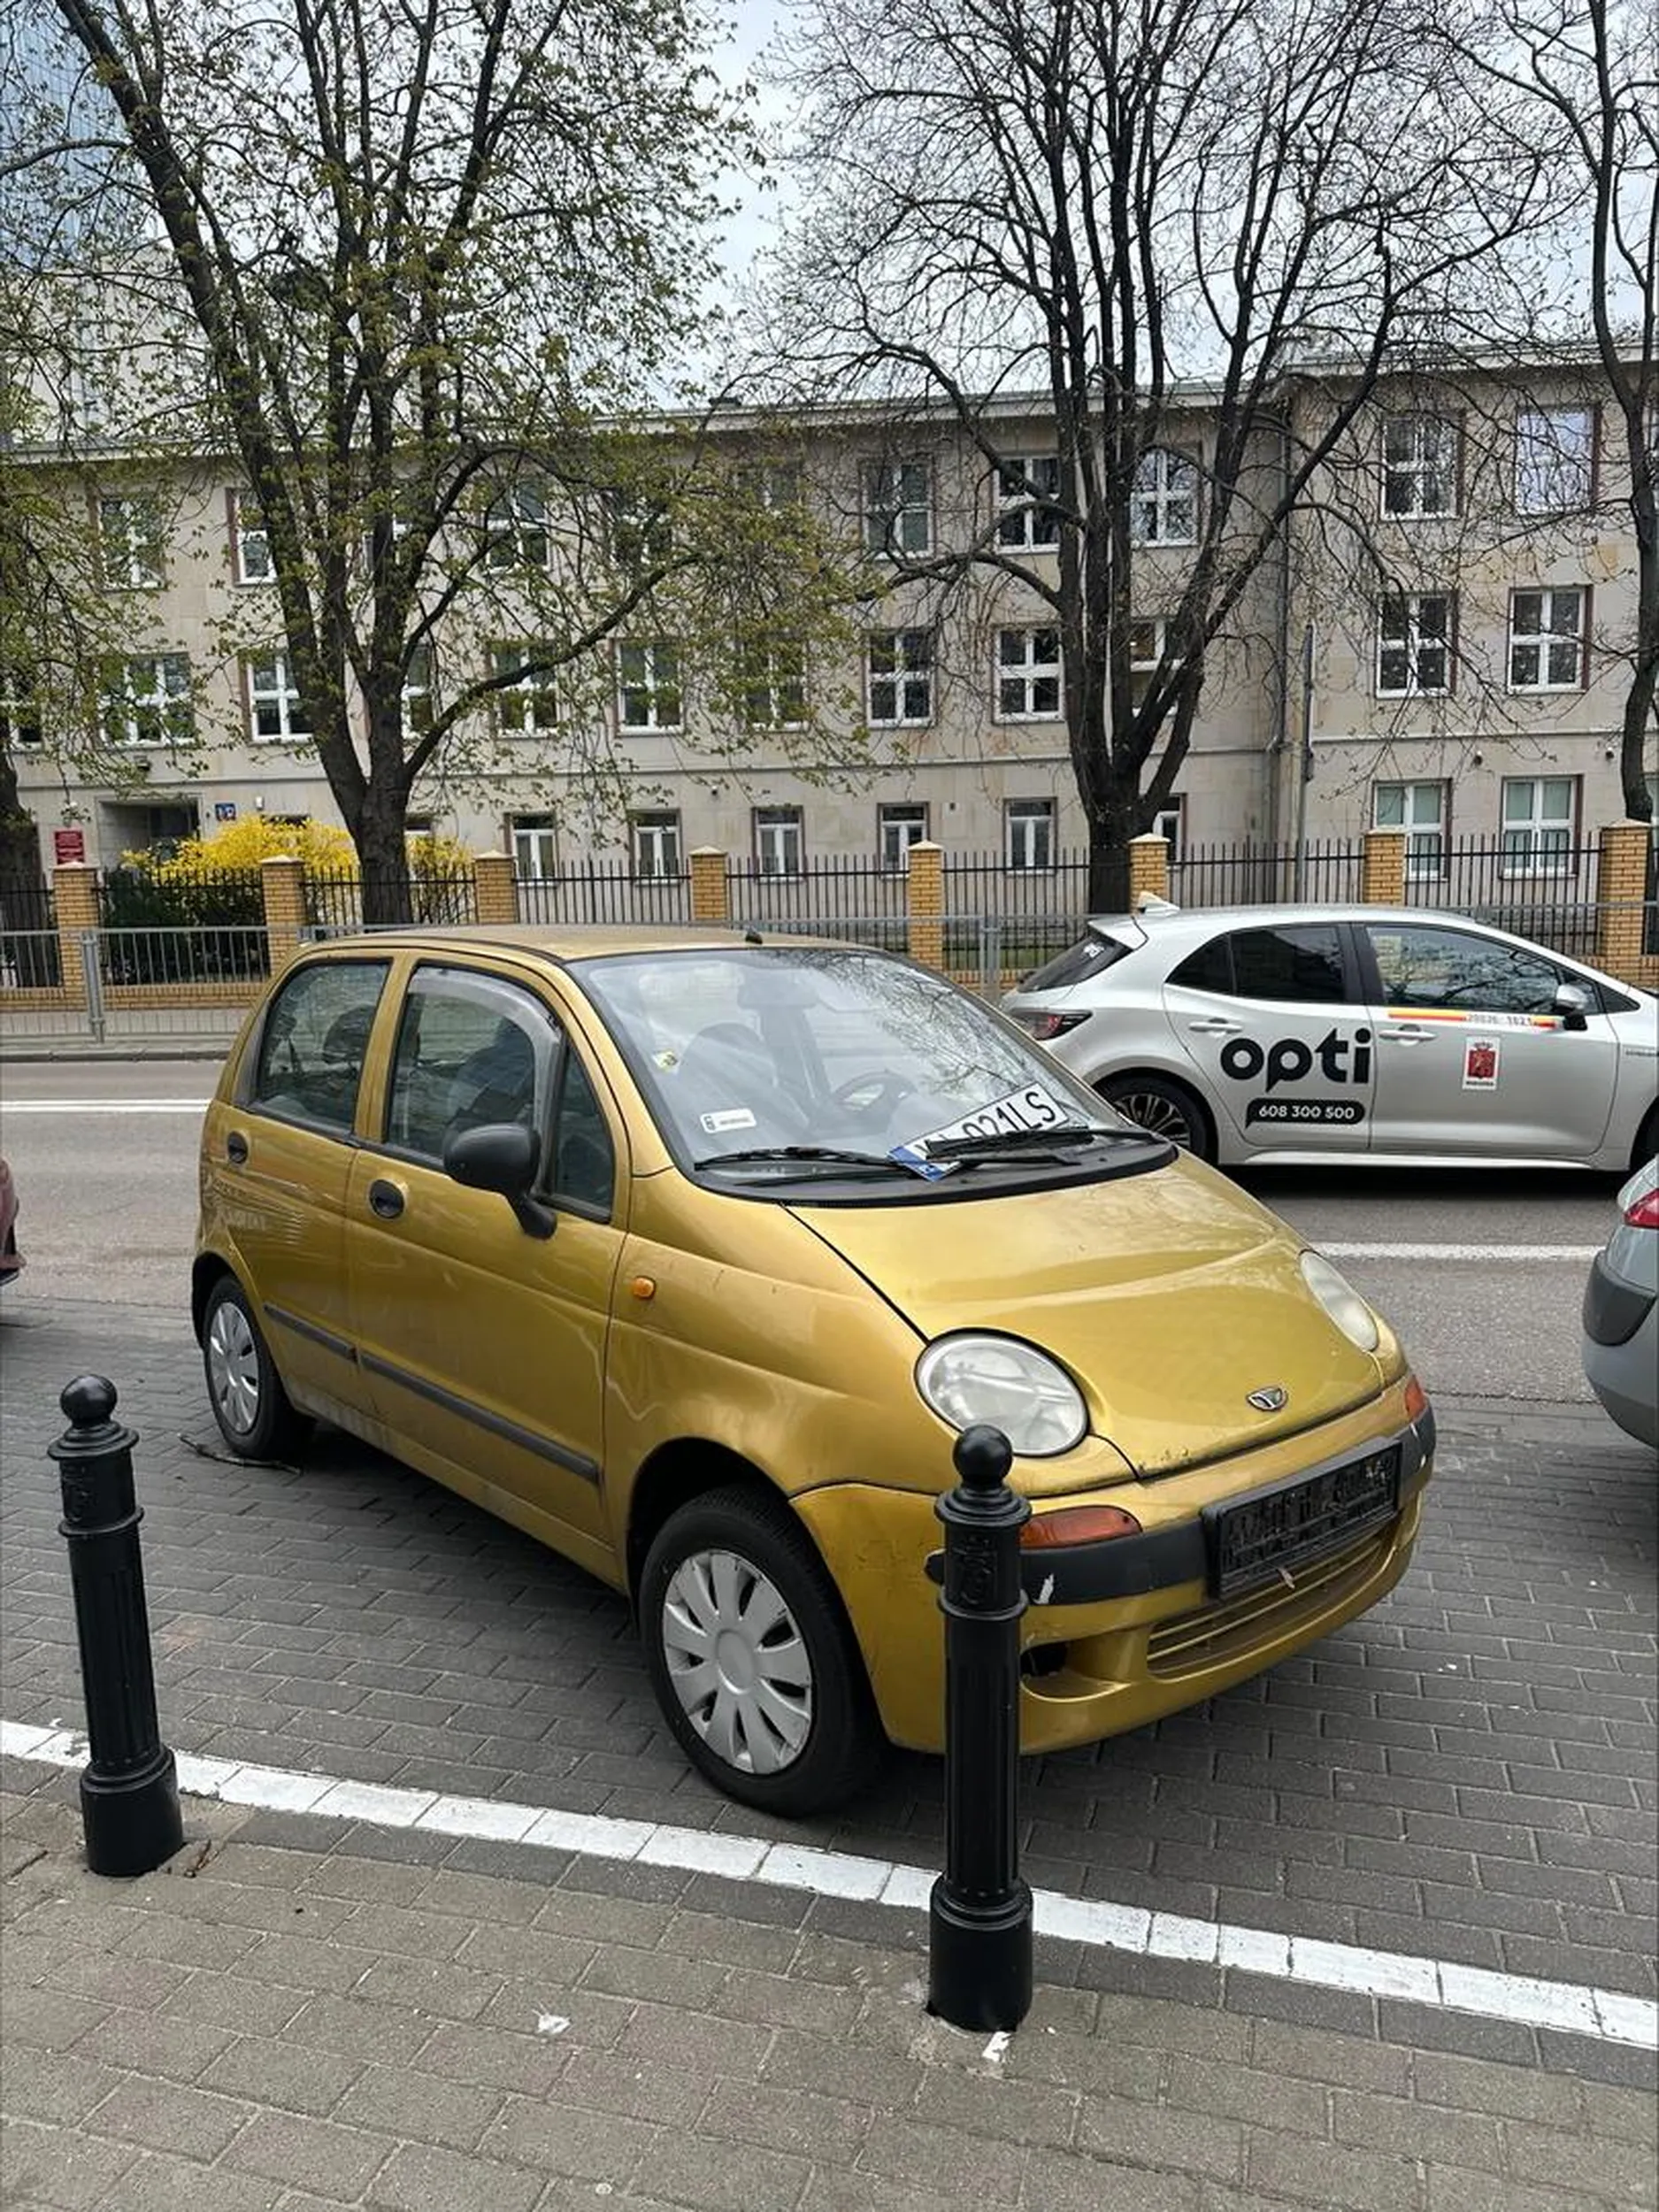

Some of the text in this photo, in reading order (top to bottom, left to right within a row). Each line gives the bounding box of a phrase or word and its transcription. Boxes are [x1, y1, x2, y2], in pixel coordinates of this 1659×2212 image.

[1220, 1028, 1371, 1093] opti
[1258, 1105, 1355, 1119] 608 300 500
